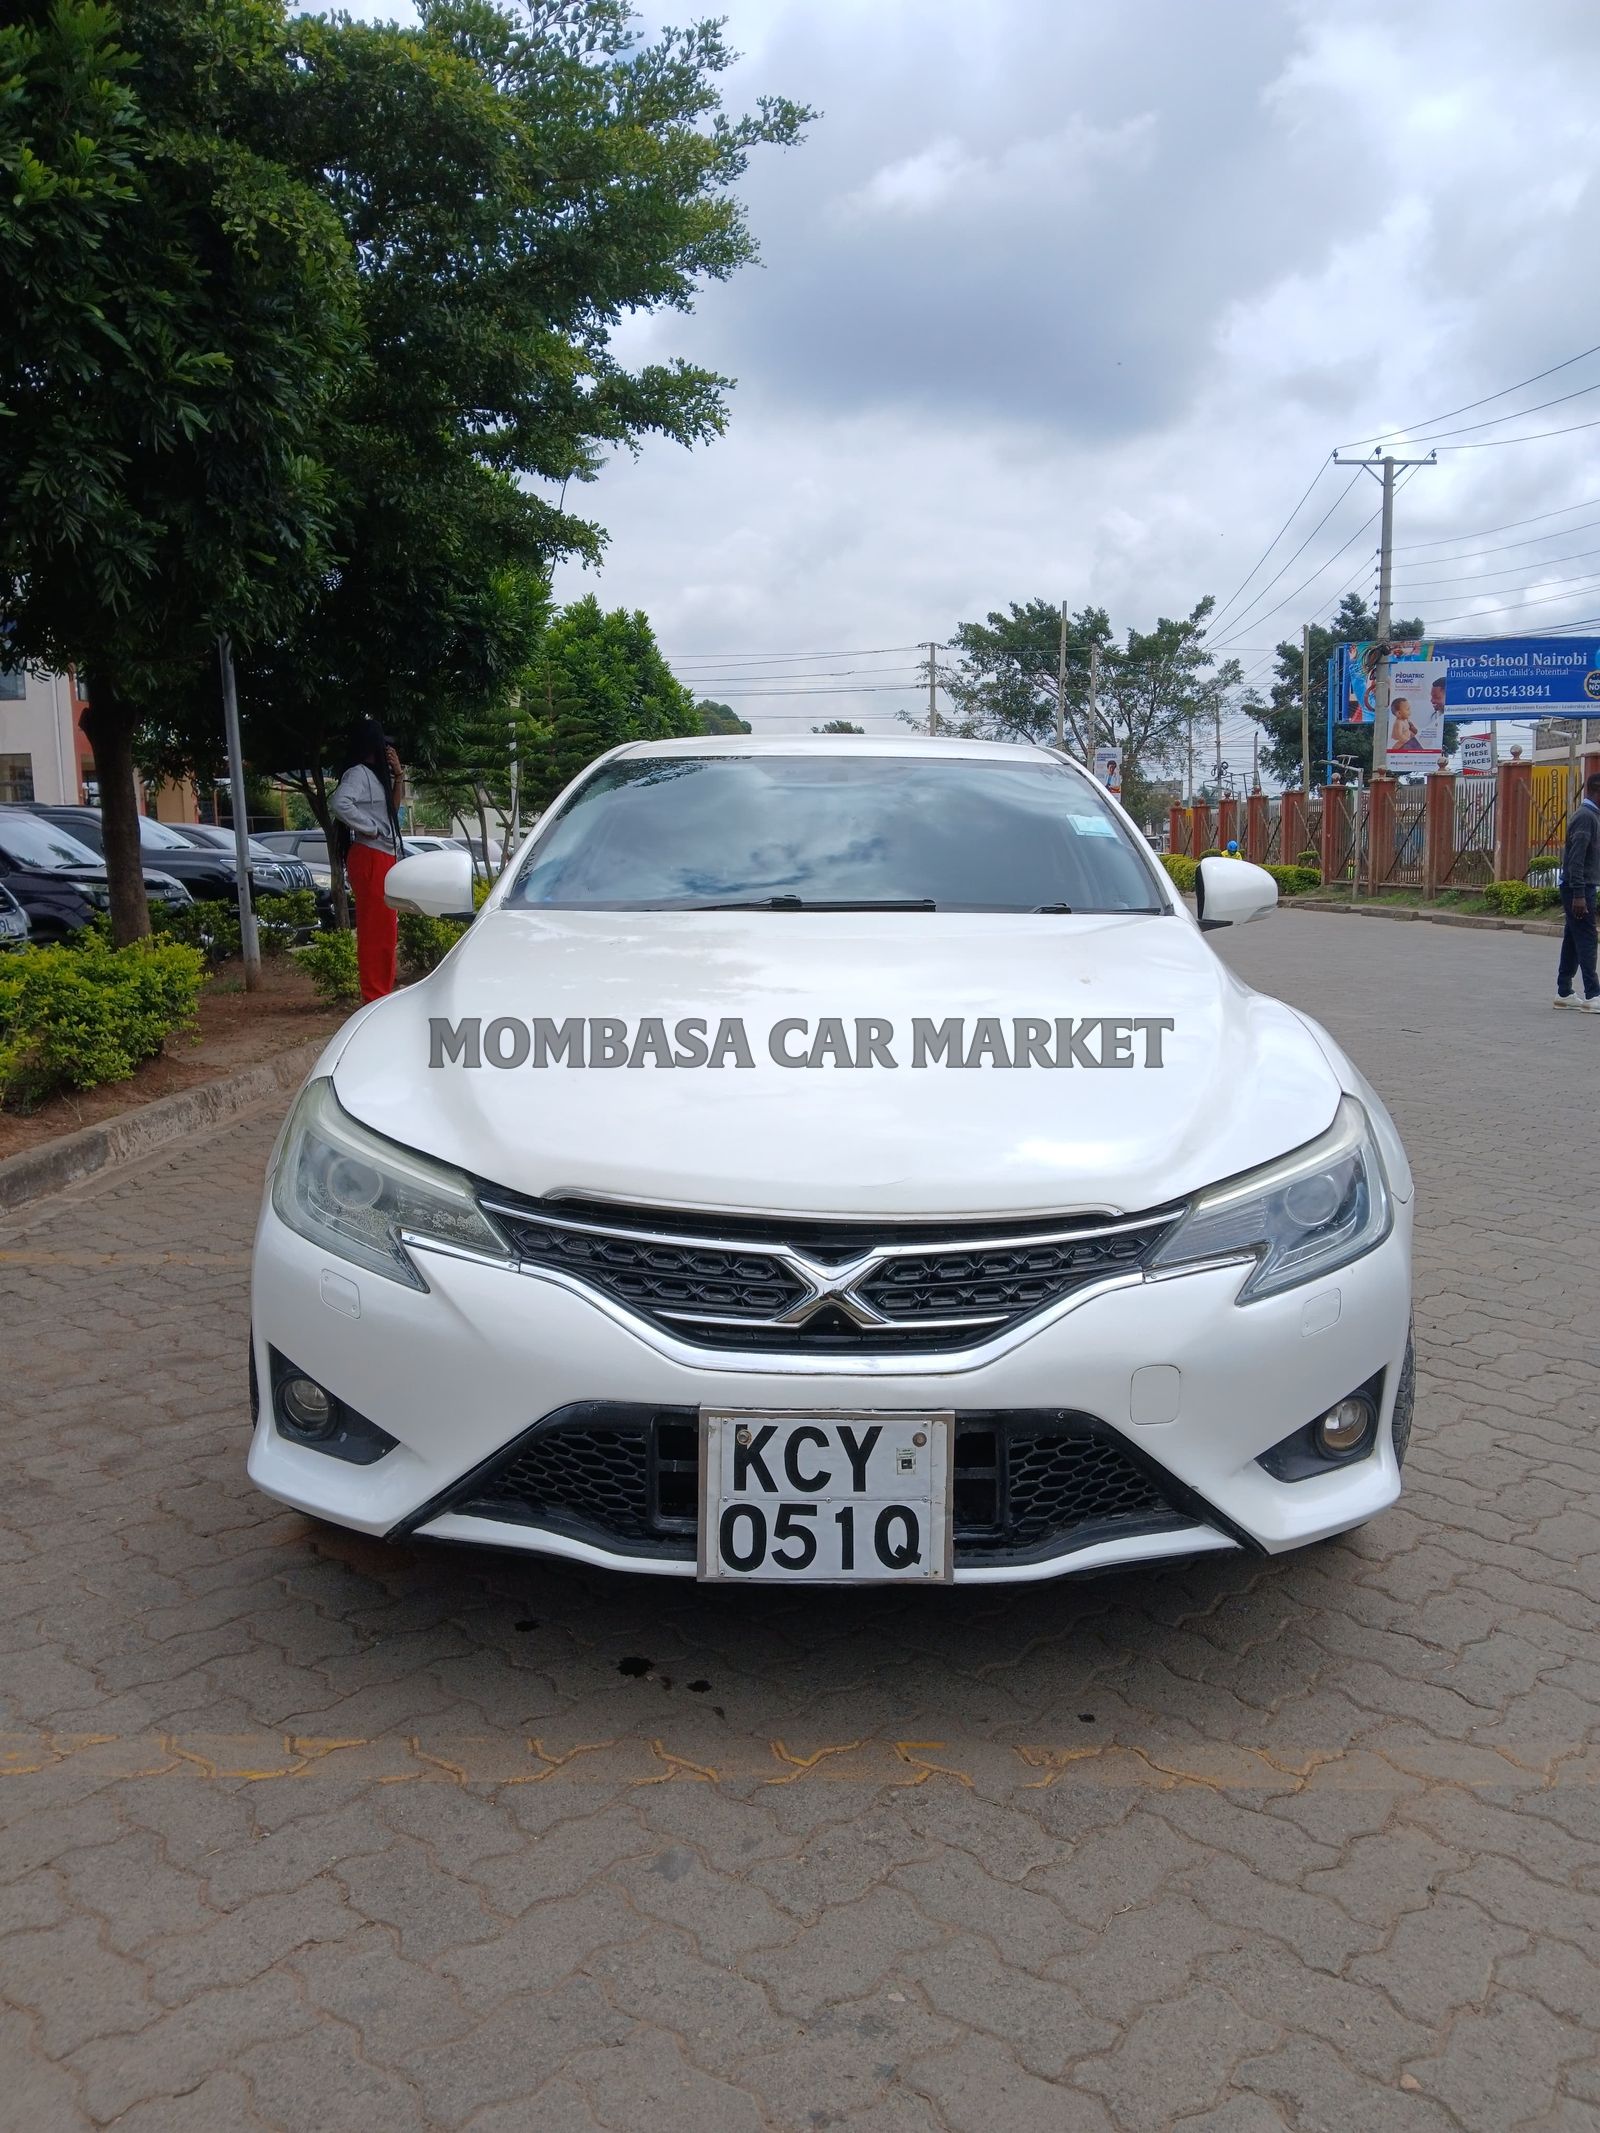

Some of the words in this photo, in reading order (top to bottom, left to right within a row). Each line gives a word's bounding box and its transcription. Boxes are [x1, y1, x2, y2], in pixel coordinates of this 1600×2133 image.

[1479, 653, 1528, 667] School
[1533, 652, 1588, 666] Nairobi
[1450, 670, 1488, 678] Unlocking
[1489, 669, 1507, 677] Each
[1509, 668, 1534, 676] Child's
[1536, 668, 1569, 676] Potential
[1467, 685, 1551, 698] 0703543841
[1465, 742, 1487, 750] BOOK
[733, 1423, 883, 1493] KCY
[719, 1503, 922, 1572] 051Q
